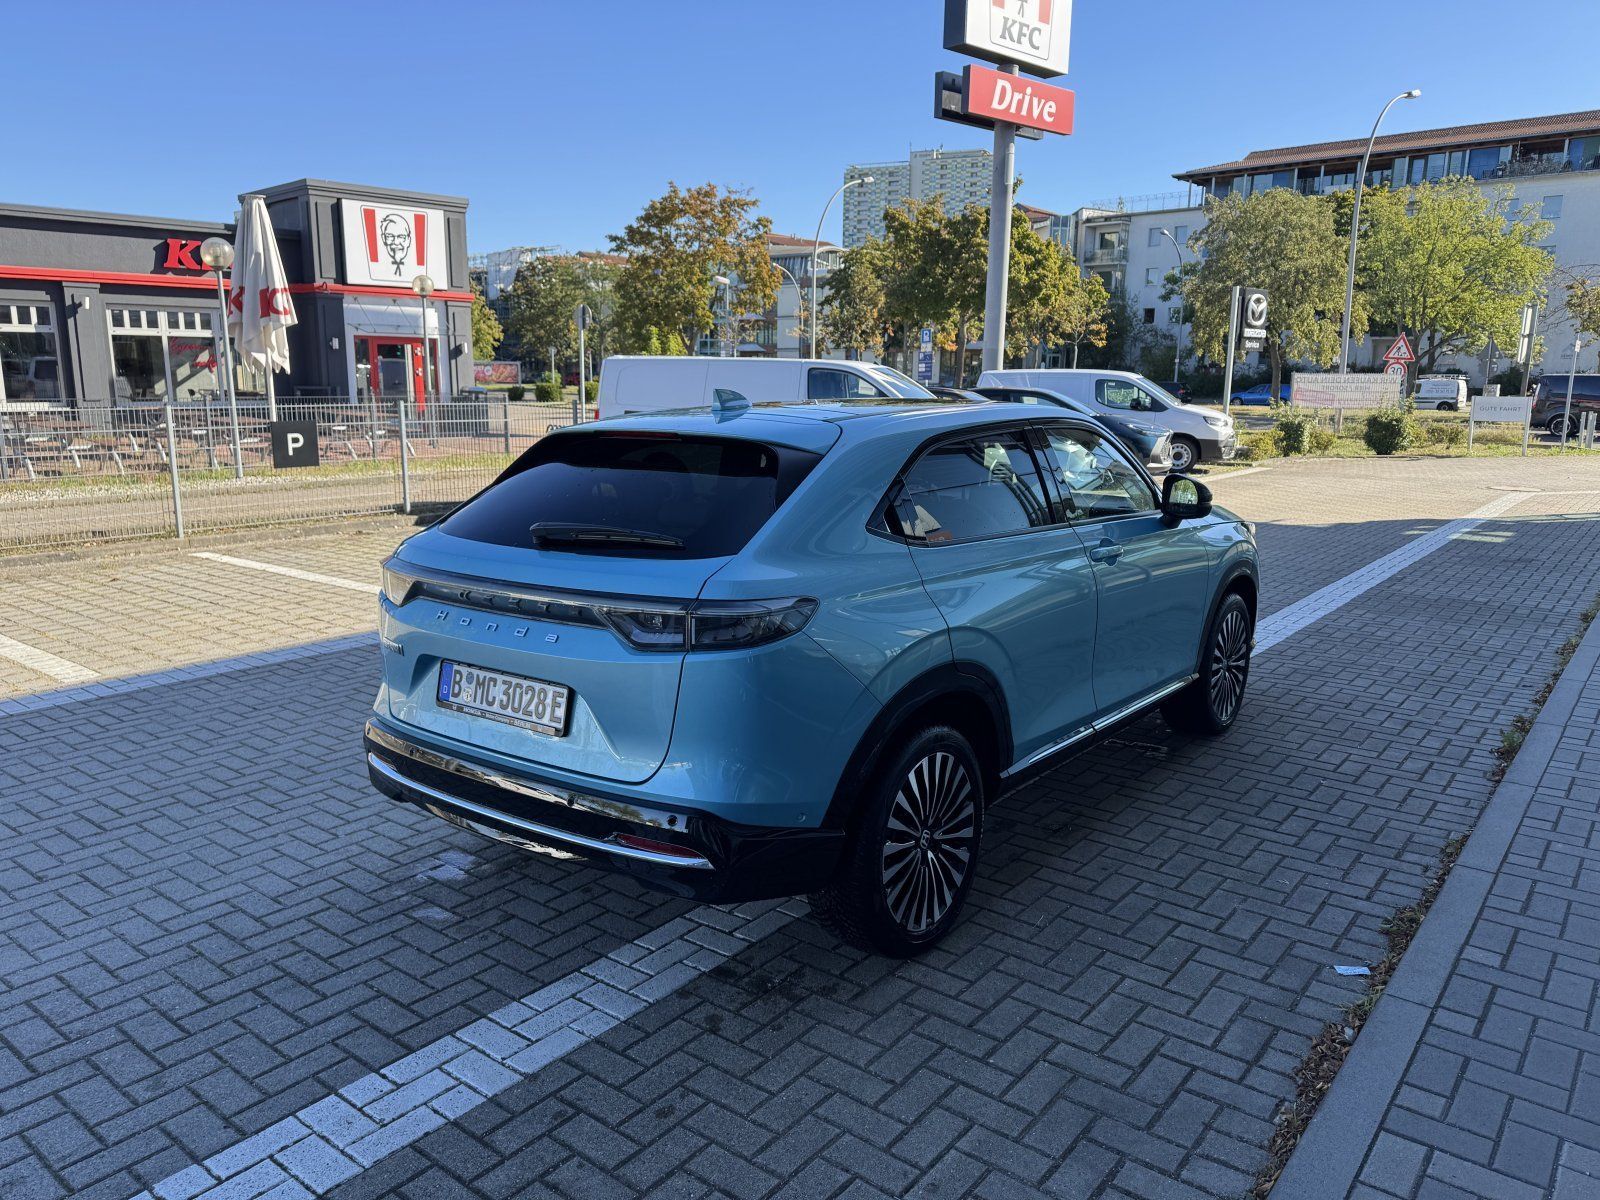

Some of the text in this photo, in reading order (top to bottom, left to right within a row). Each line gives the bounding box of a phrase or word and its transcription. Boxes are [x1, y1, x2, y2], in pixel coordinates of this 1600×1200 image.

[1000, 16, 1042, 50] KFC
[991, 78, 1057, 122] Drive
[287, 433, 304, 456] P
[436, 610, 559, 644] Honda
[451, 669, 463, 698] B
[474, 673, 498, 707] MC
